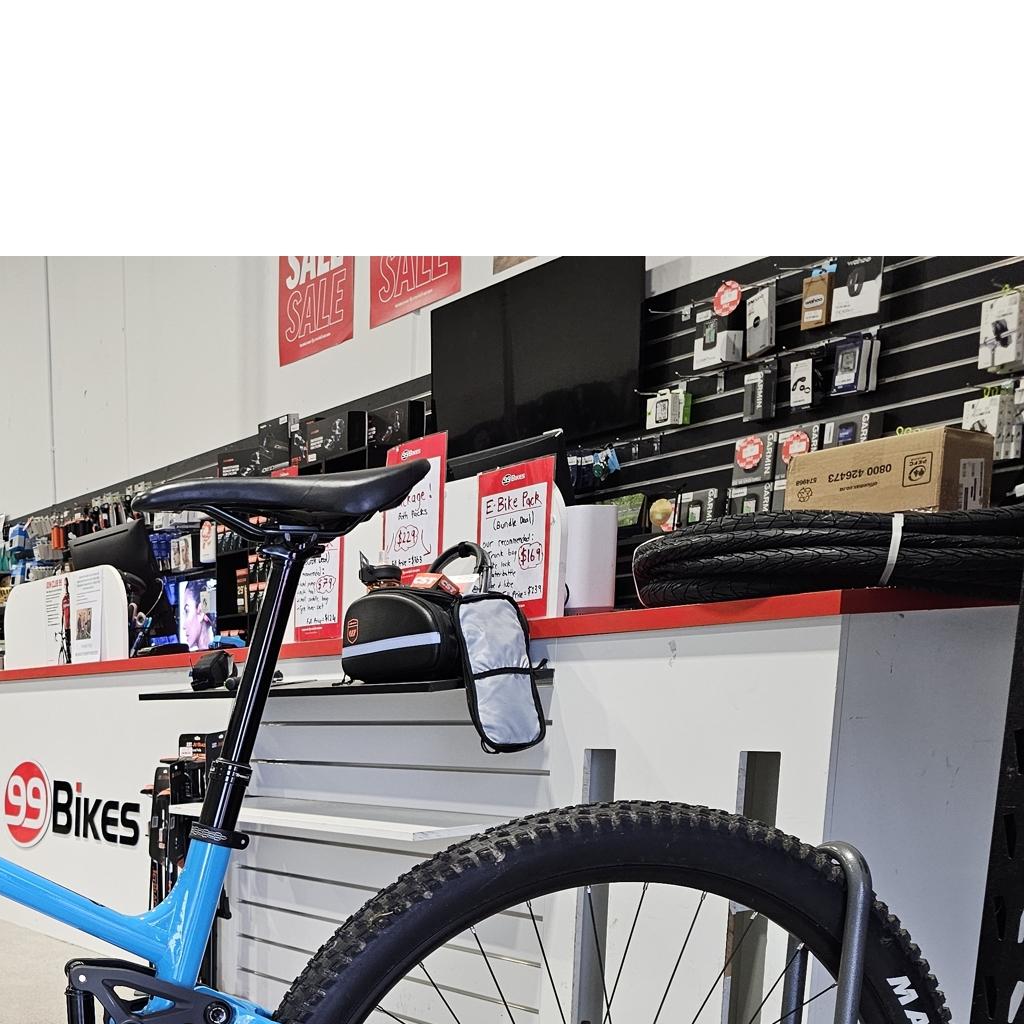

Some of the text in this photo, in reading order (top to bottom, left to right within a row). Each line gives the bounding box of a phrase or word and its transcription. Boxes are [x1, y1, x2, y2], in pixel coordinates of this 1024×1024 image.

[285, 268, 347, 342] SALE
[764, 433, 774, 475] GARMIN
[828, 463, 893, 483] 0800 426473
[522, 491, 543, 509] Pack
[397, 530, 417, 547] $229
[521, 547, 542, 566] $169
[4, 774, 48, 830] 99
